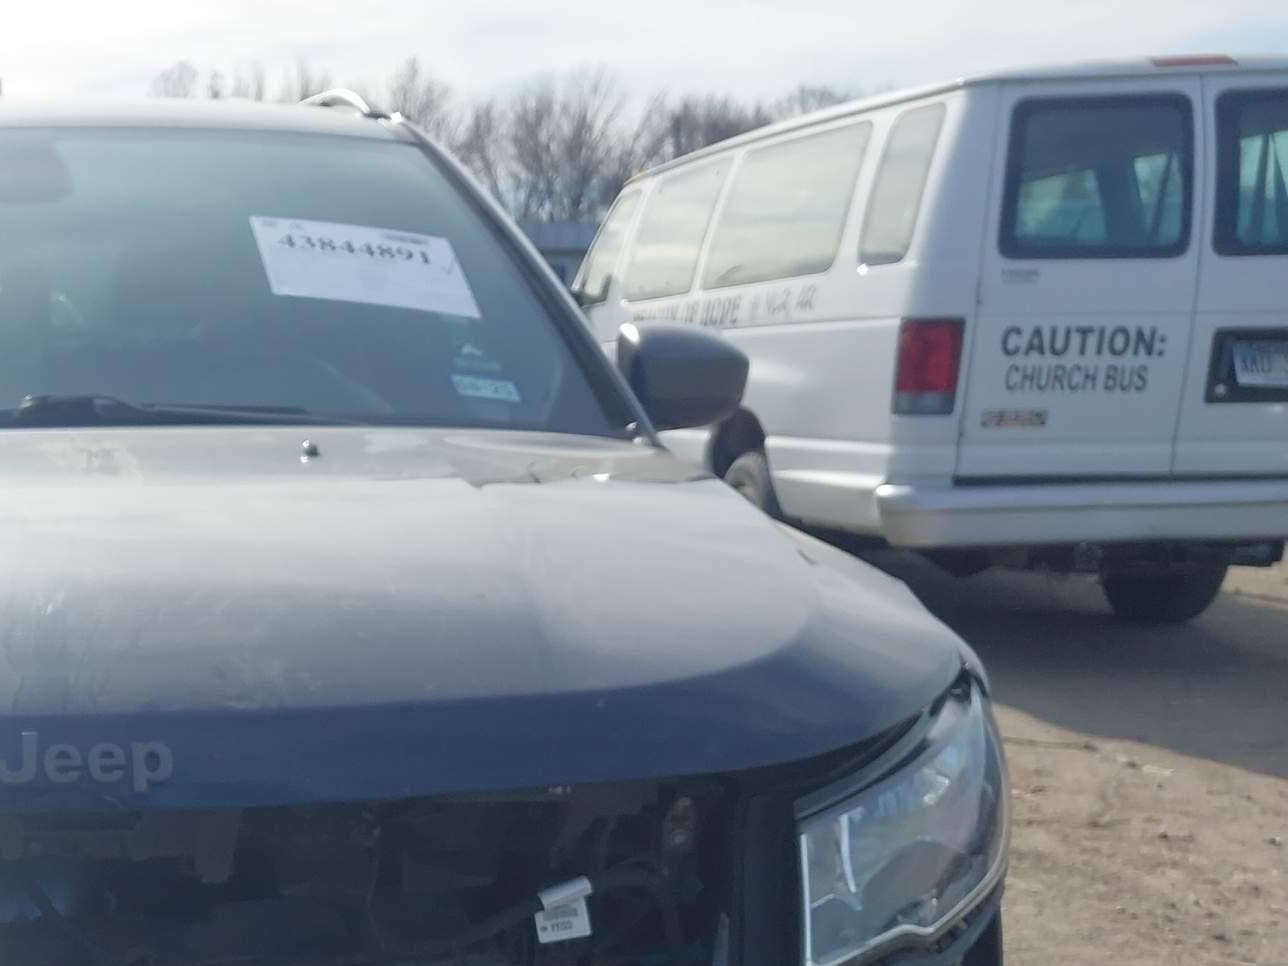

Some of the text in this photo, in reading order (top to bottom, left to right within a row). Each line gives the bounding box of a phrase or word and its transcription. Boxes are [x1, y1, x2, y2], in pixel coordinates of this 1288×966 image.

[278, 232, 432, 265] 43844891
[1000, 324, 1168, 358] CAUTION:
[1004, 363, 1150, 392] CHURCH BUS
